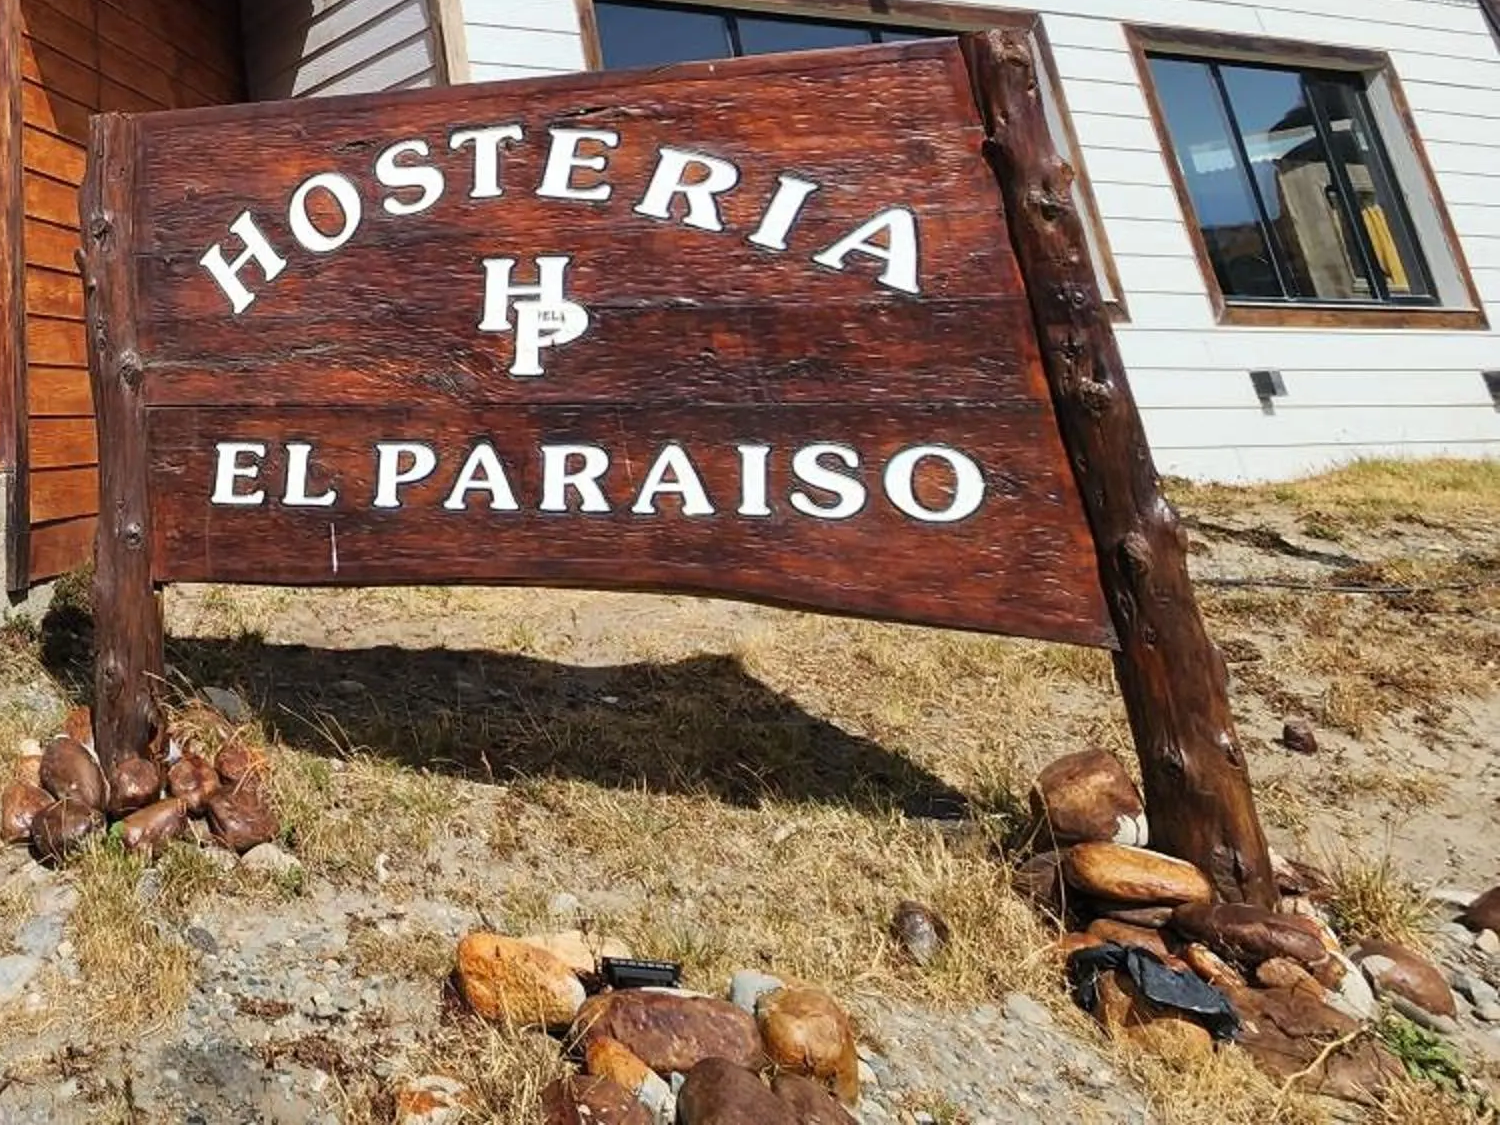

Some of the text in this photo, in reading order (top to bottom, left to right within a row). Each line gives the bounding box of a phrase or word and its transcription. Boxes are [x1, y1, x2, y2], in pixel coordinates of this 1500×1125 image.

[199, 124, 920, 314] HOSTERIA
[211, 443, 986, 522] EL PARAISO
